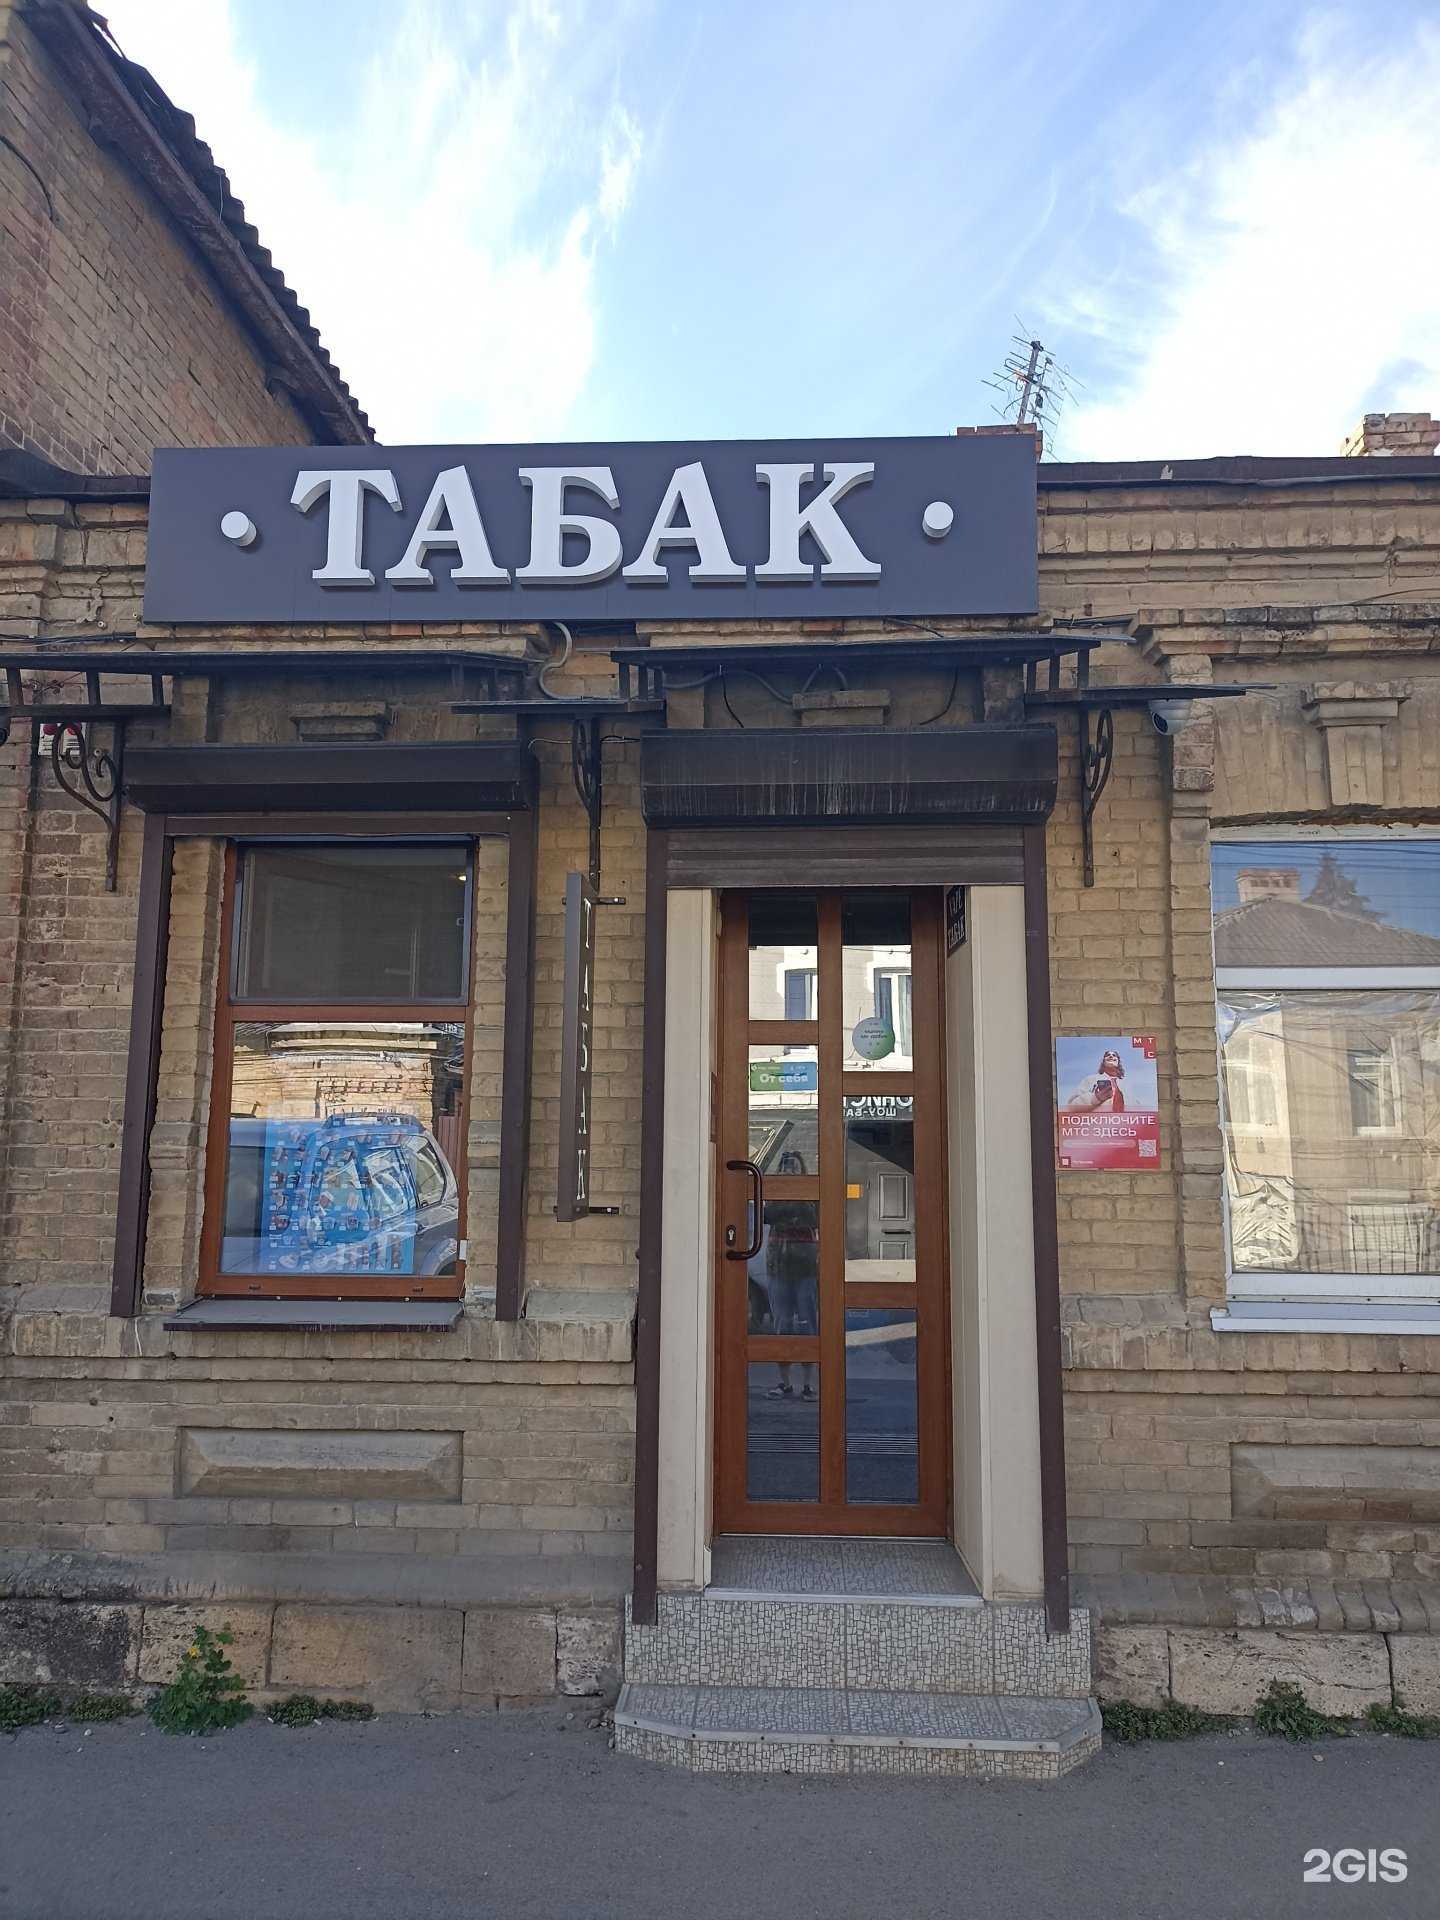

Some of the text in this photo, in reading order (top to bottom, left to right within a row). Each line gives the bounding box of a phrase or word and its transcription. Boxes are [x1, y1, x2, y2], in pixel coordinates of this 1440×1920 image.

[290, 461, 882, 587] ТАБАК
[760, 1073, 808, 1083] От себя
[1062, 1116, 1156, 1126] ПОДКЛЮЧИТЕ
[1062, 1127, 1137, 1138] МТС ЗДЕСЬ
